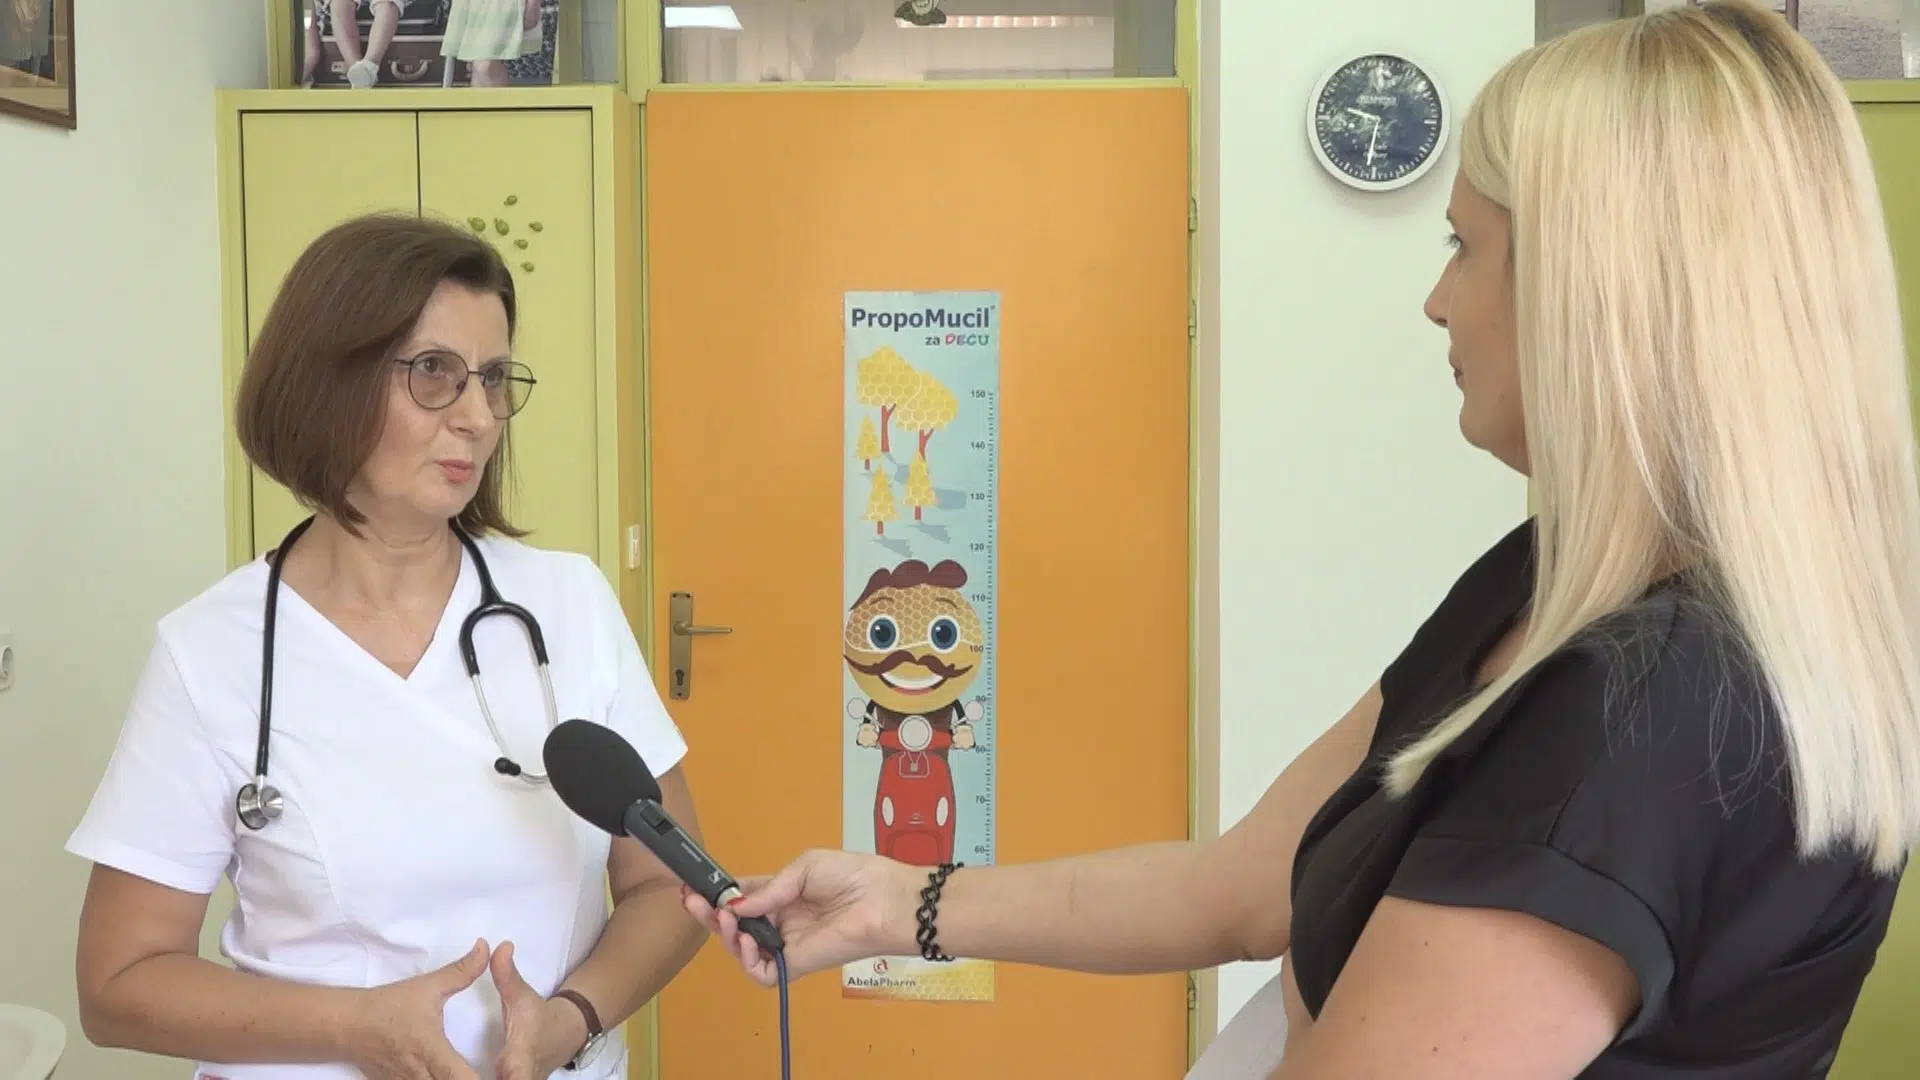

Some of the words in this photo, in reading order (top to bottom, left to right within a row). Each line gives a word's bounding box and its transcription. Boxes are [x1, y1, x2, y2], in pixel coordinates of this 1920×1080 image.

[851, 308, 990, 332] PropoMucil
[925, 337, 940, 346] za
[970, 390, 986, 398] 150
[970, 441, 986, 449] 140
[969, 543, 985, 551] 120
[969, 645, 984, 653] 100
[975, 795, 986, 804] 70
[974, 845, 986, 854] 60
[847, 977, 917, 988] AbelaPharm
